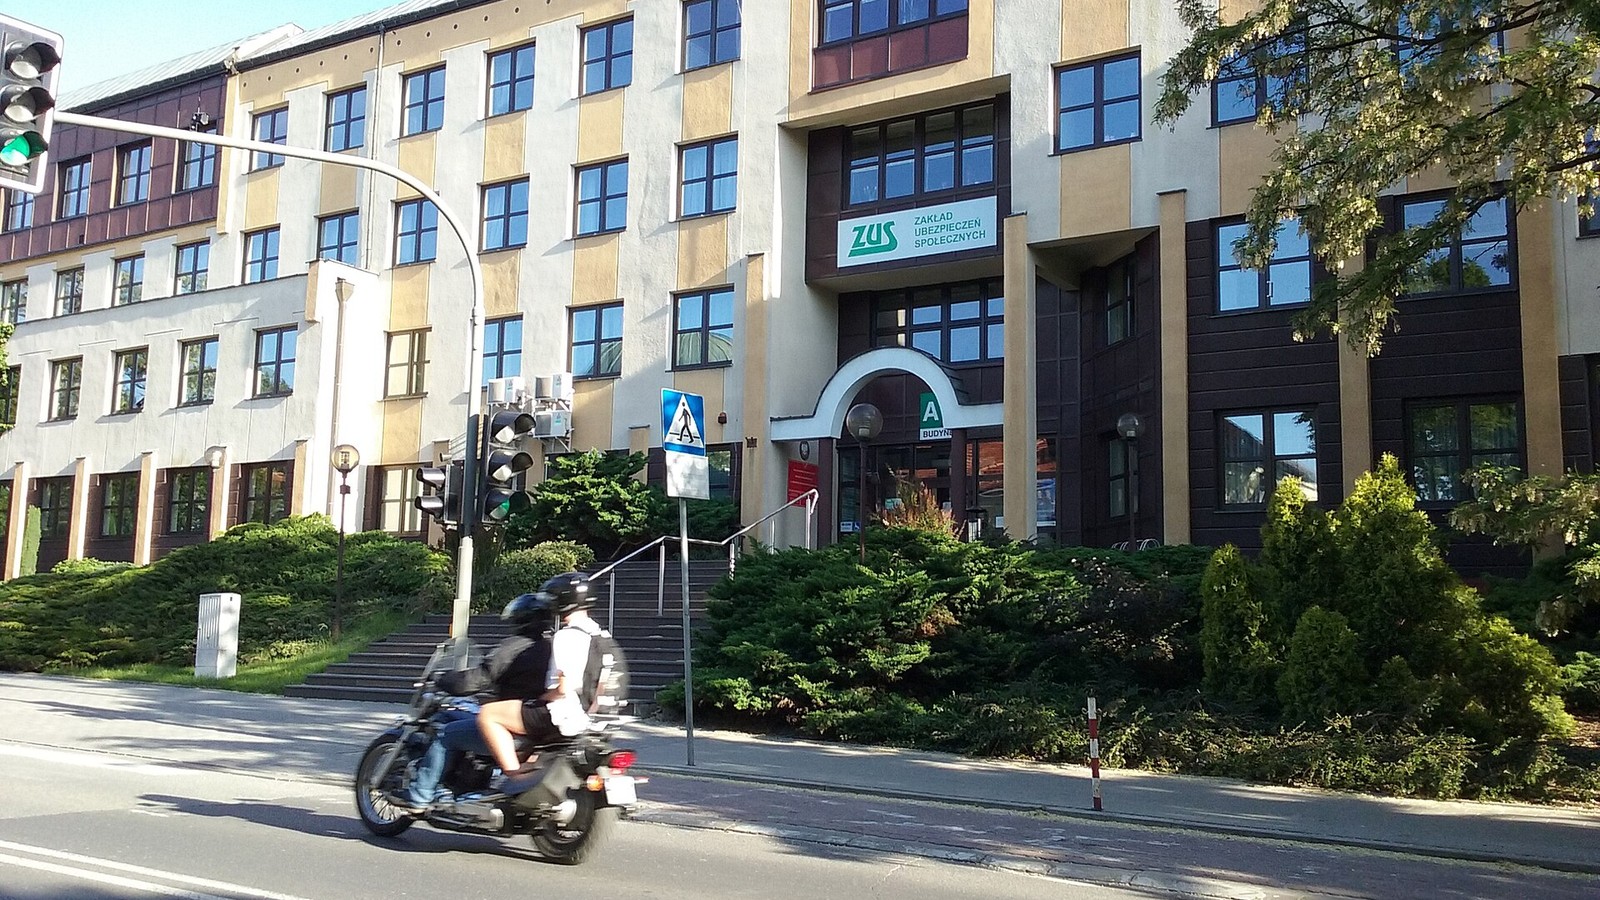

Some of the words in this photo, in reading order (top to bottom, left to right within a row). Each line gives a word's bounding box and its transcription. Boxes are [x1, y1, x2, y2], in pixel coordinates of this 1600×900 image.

[914, 211, 953, 226] ZAKŁAD
[914, 217, 981, 237] UBEZPIECZEŃ
[848, 220, 898, 258] ZUS
[914, 230, 986, 249] SPOŁECZNYCH
[922, 401, 939, 422] A
